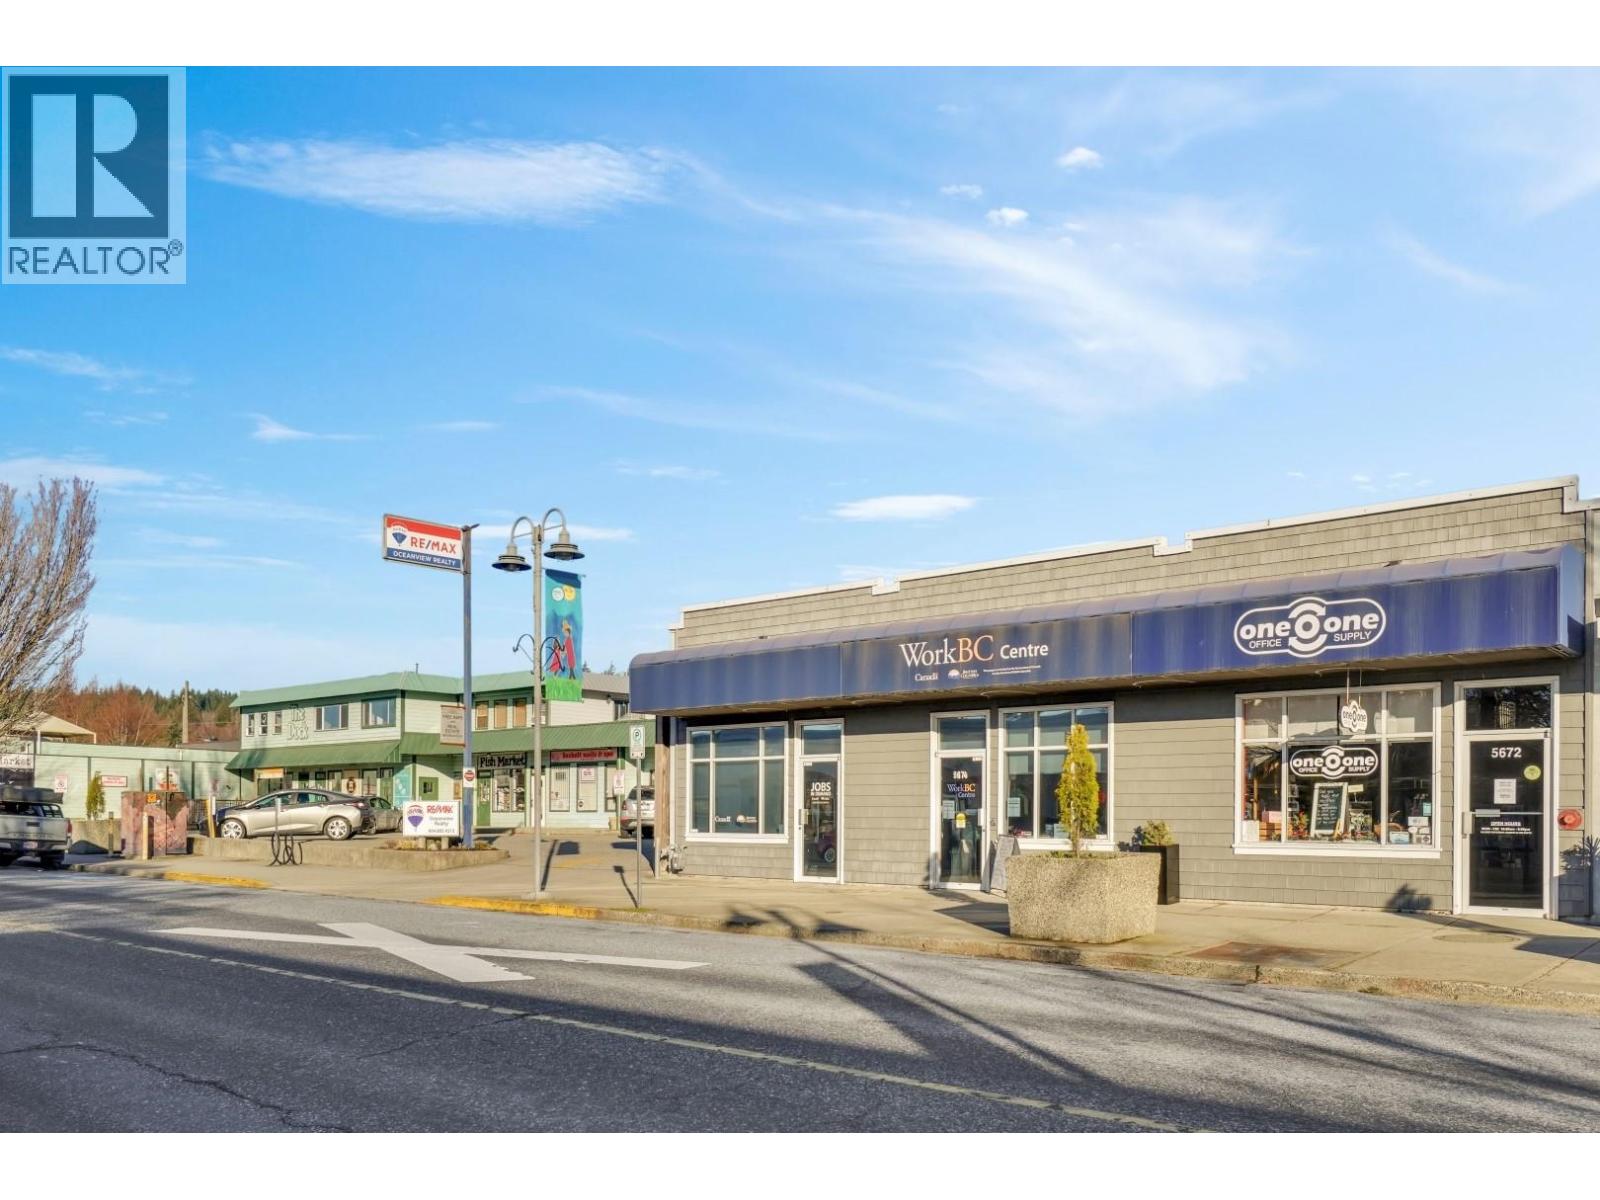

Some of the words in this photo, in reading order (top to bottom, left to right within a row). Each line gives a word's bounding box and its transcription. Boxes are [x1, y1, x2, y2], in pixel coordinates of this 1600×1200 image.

[410, 536, 457, 554] RE/MAX
[393, 550, 432, 562] OCEANVIEW
[433, 557, 456, 566] REALTY
[1239, 620, 1291, 640] one
[1323, 612, 1380, 633] one
[1249, 638, 1282, 649] OFFICE
[1333, 631, 1372, 642] SUPPLY
[898, 635, 994, 667] WorkBC
[1000, 644, 1049, 659] Centre
[1490, 747, 1522, 758] 5672
[480, 757, 495, 768] Fish
[497, 755, 527, 767] Market
[1292, 756, 1324, 767] one
[1342, 755, 1376, 767] one
[810, 782, 831, 792] JOBS
[947, 783, 976, 792] WorkBC
